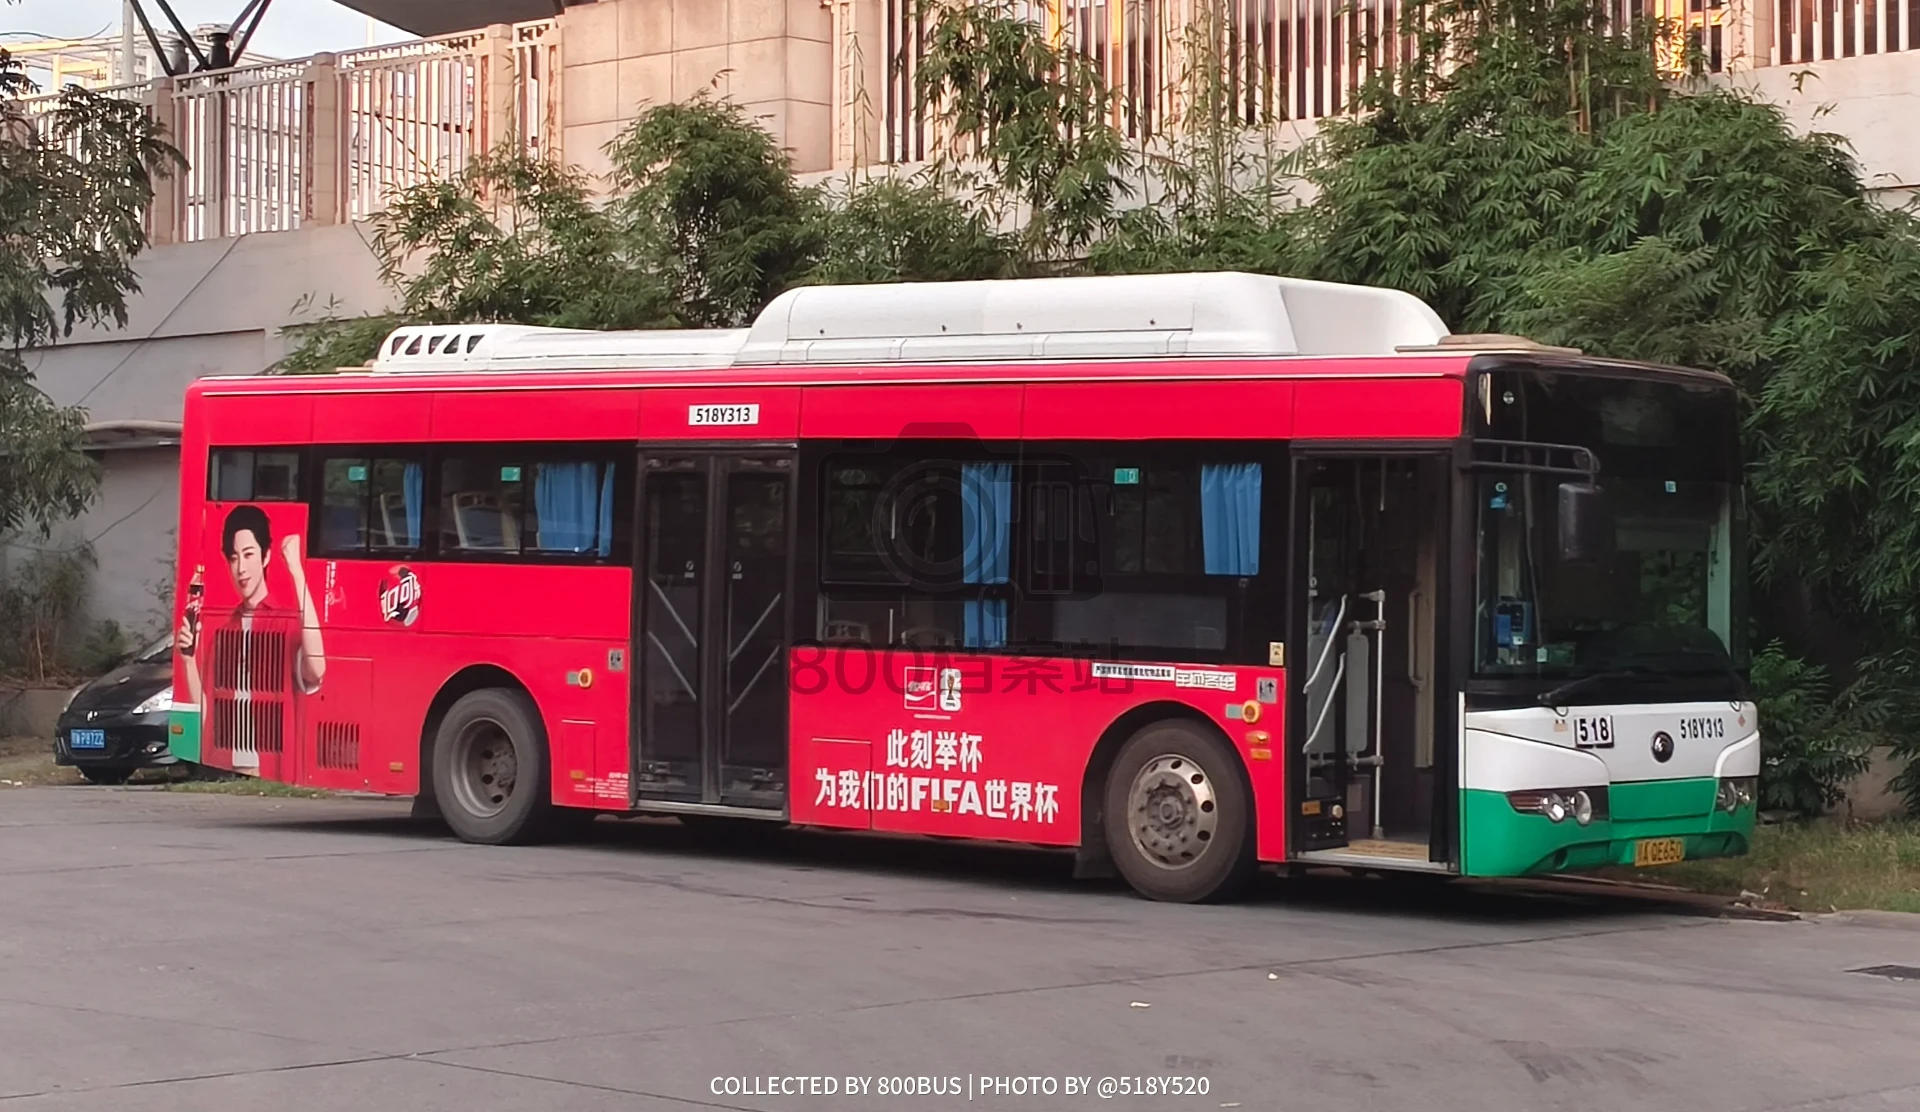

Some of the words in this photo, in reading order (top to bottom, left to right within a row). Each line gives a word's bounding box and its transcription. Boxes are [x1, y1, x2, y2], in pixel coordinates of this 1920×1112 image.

[696, 407, 750, 423] 518Y313
[1579, 717, 1609, 742] 518
[1680, 717, 1725, 739] 518Y313
[886, 728, 983, 773] 此刻举杯
[815, 768, 1060, 824] 为我们的FIFA世界杯
